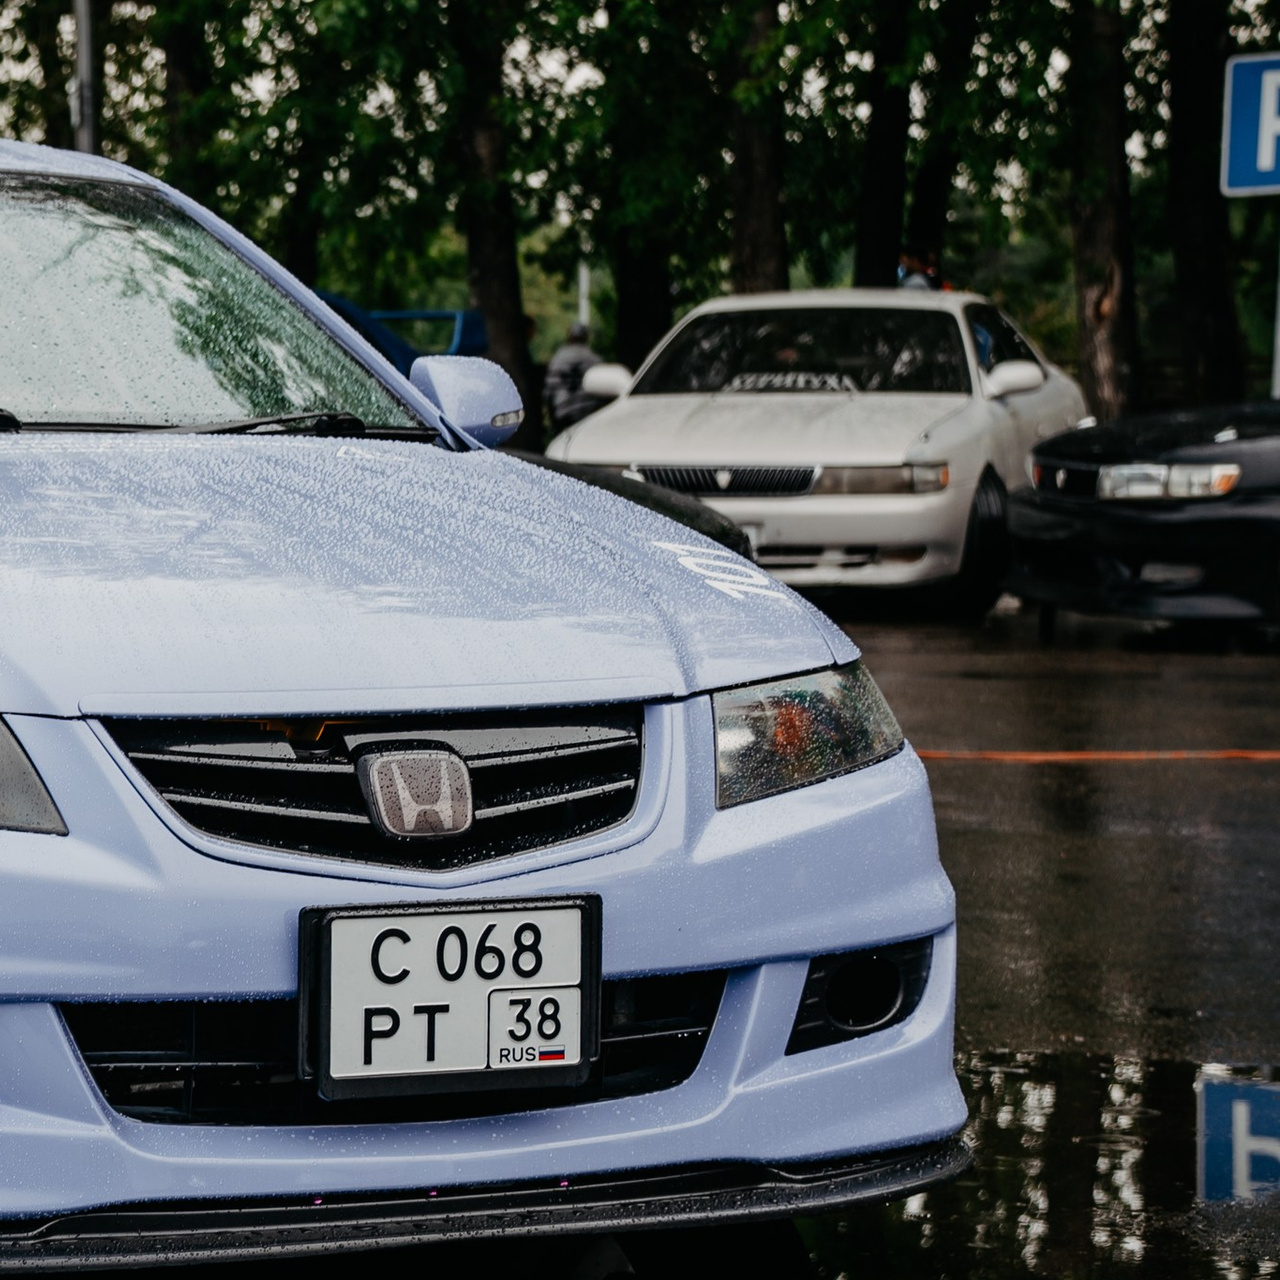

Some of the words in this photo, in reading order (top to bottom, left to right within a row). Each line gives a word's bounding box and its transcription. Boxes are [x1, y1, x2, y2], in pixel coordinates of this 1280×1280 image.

[436, 922, 543, 982] 068
[508, 997, 561, 1042] 38
[499, 1047, 536, 1063] RUS
